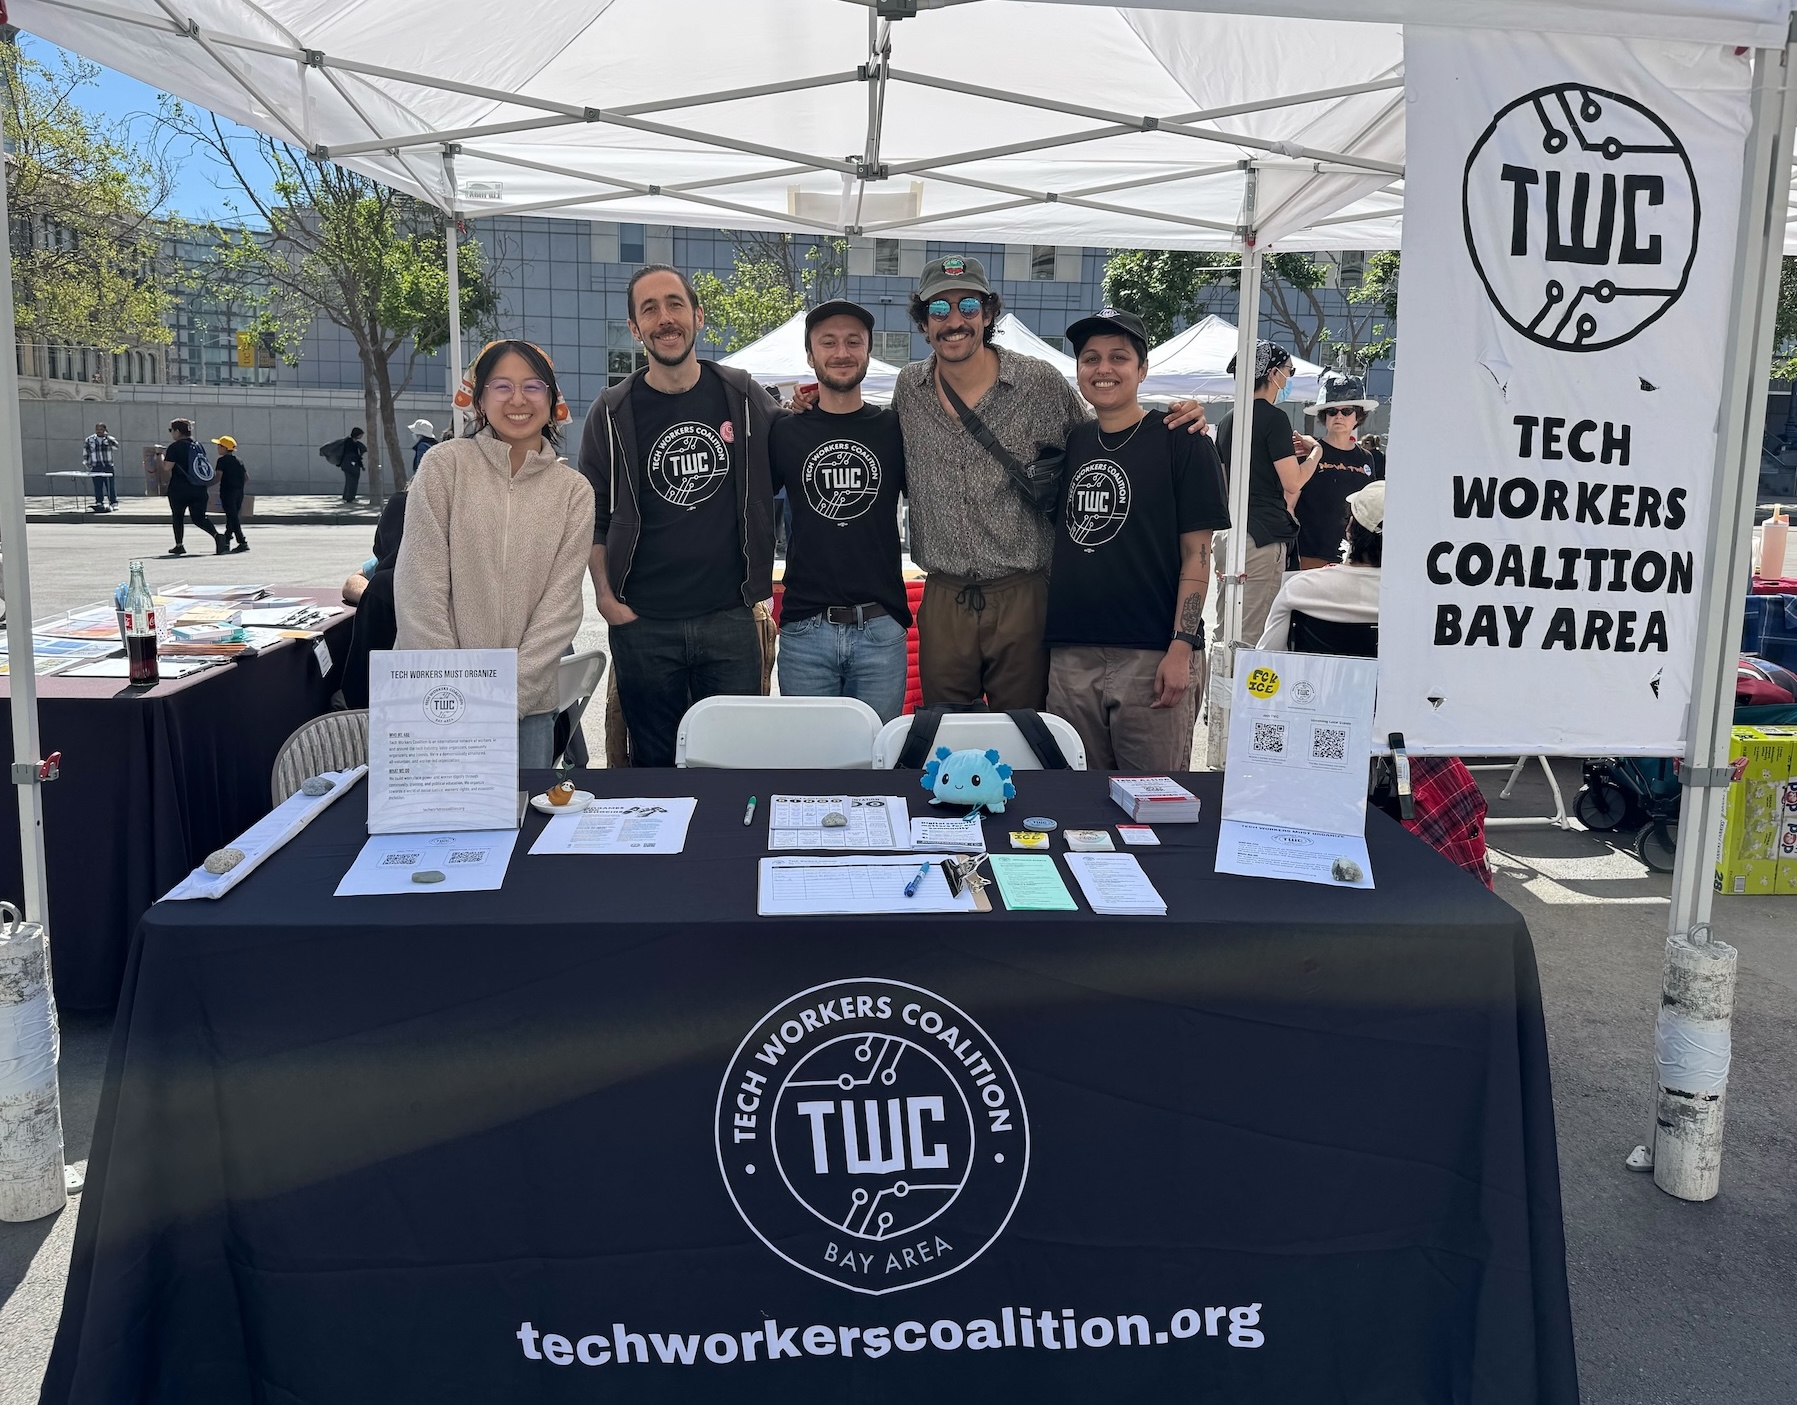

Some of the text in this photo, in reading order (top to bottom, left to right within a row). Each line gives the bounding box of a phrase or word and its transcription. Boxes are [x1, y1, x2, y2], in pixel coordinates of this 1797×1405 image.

[1500, 163, 1664, 266] TWC
[652, 426, 725, 471] TECH WORKERS COALITION
[1513, 414, 1631, 466] TECH
[669, 452, 709, 476] TWC
[806, 443, 878, 482] TECH WORKERS COALITION
[821, 468, 861, 489] TWC
[1075, 463, 1107, 481] WORKERS
[1107, 465, 1126, 504] COALITION
[1077, 490, 1110, 513] TWC
[1453, 475, 1687, 530] WORKERS
[1426, 541, 1693, 594] COALITION
[1433, 604, 1669, 653] BAY AREA
[391, 669, 497, 679] TECH WORKERS MUST ORGANIZE
[1249, 681, 1273, 694] ICE
[1252, 669, 1278, 684] FCK
[434, 700, 455, 710] TWC
[734, 995, 1012, 1144] TECH WORKERS COALITION
[797, 1095, 950, 1175] TWC
[823, 1235, 953, 1274] BAY AREA
[516, 1302, 1265, 1366] techworkerscoalition.org
